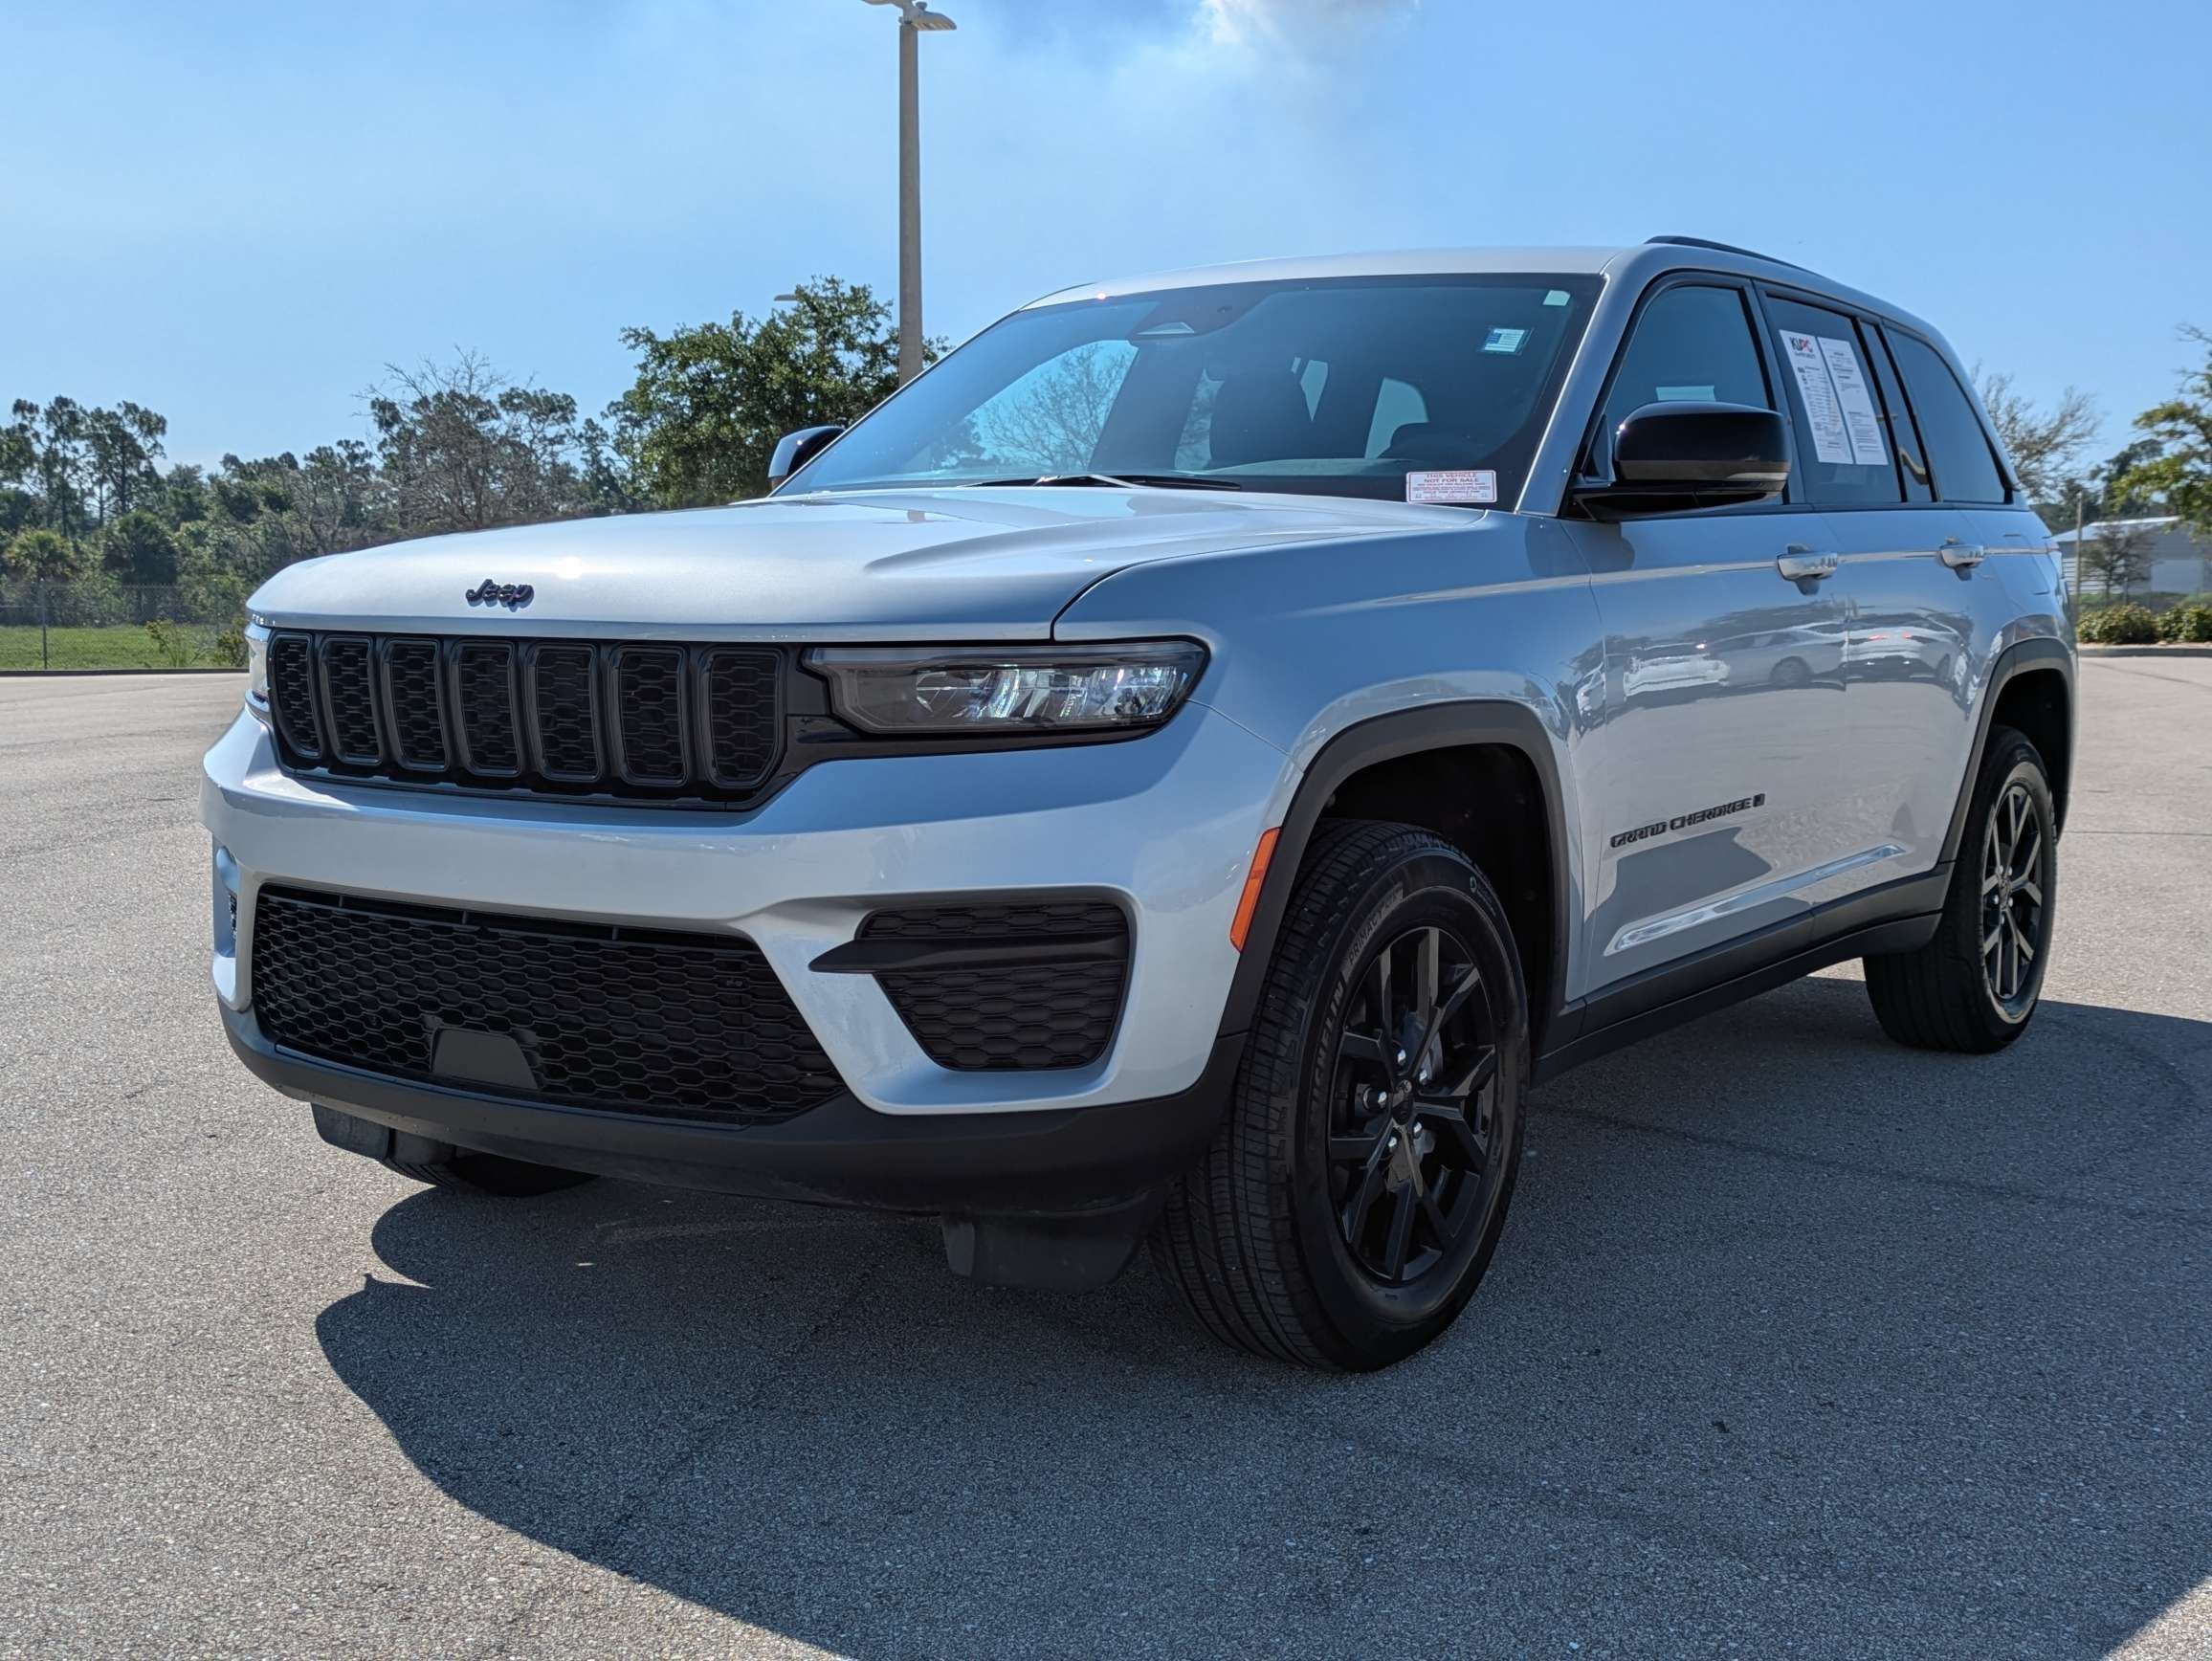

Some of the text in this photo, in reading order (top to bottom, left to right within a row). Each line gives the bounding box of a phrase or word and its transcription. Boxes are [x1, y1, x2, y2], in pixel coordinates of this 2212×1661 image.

[465, 578, 535, 609] Jeep
[1610, 797, 1752, 849] GRAND CHEROKEE
